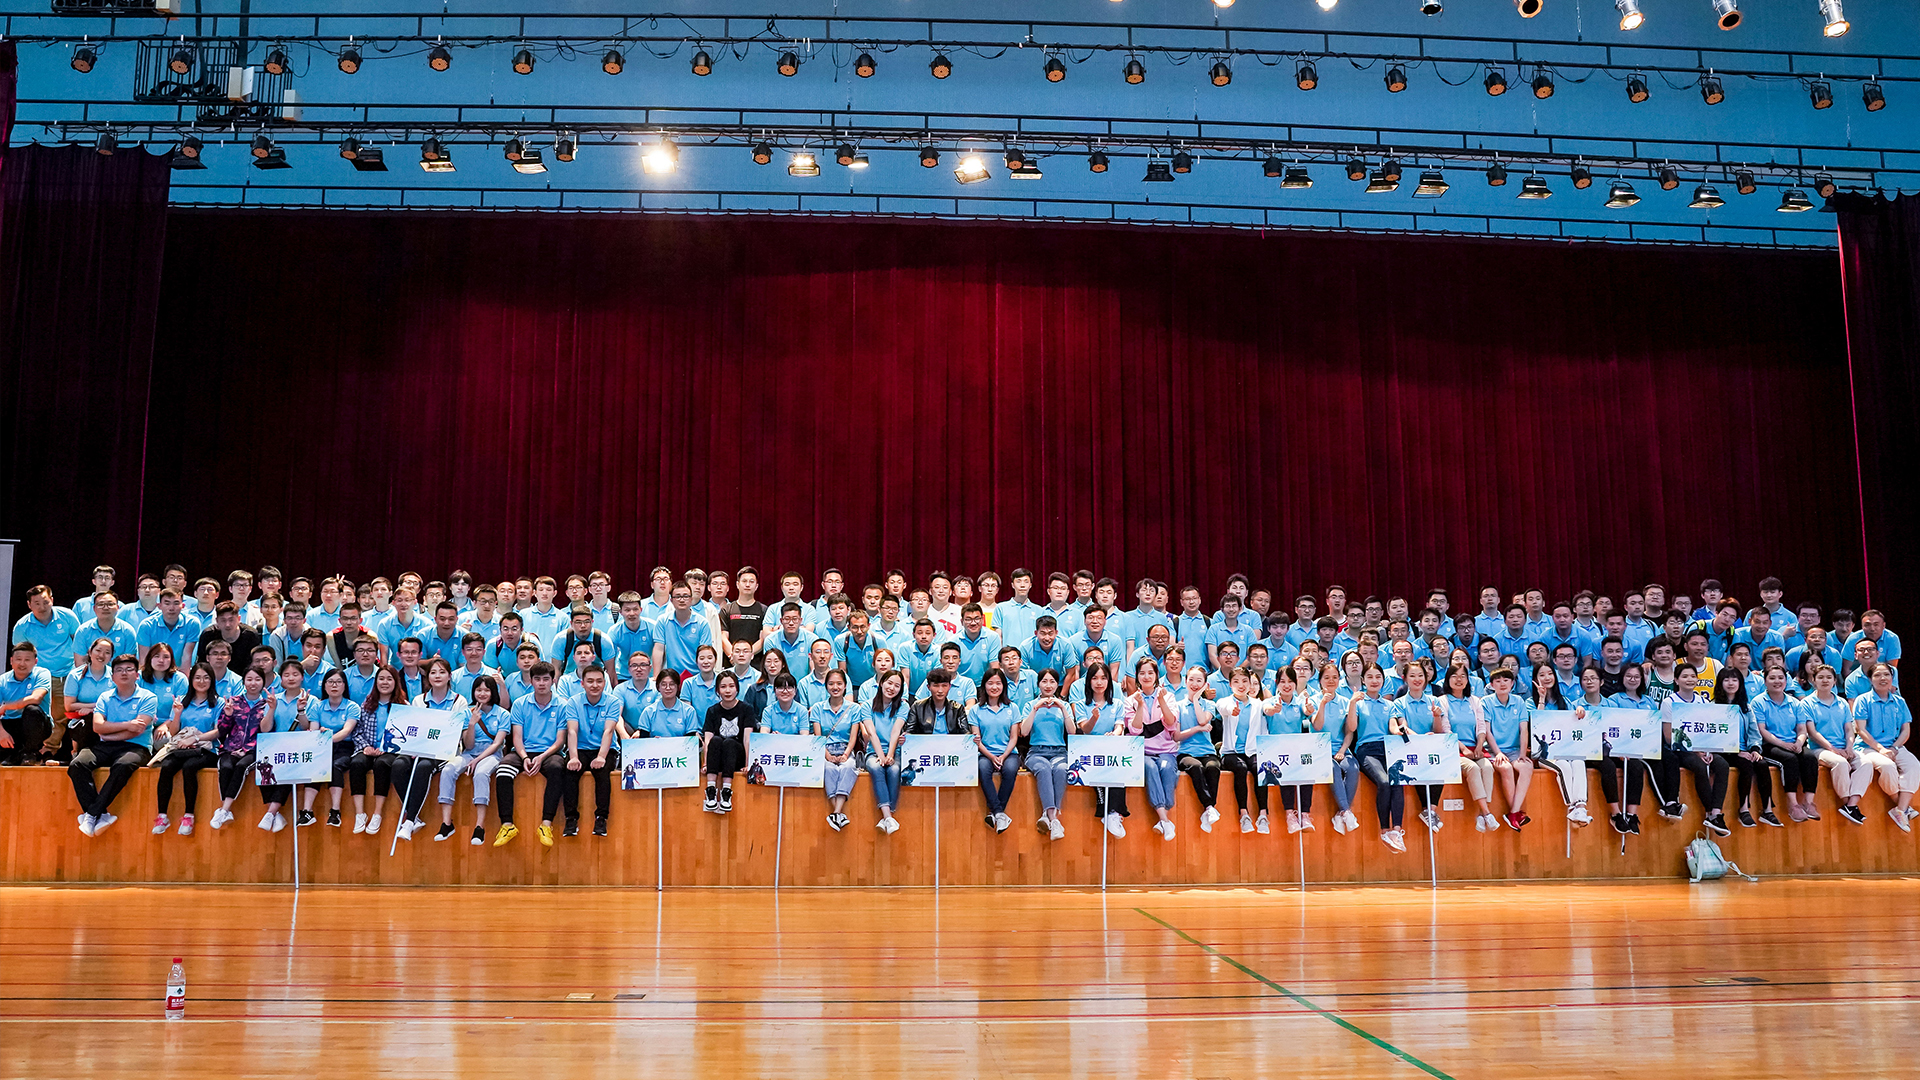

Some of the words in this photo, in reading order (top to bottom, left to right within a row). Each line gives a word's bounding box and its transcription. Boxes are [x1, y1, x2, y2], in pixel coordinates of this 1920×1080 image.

[406, 726, 441, 740] 鹰眼
[1608, 727, 1642, 739] 雷神
[1681, 721, 1729, 734] 无敌浩克
[1550, 729, 1583, 741] 幻视
[274, 752, 313, 764] 钢铁侠
[634, 756, 687, 769] 惊奇队长
[760, 754, 813, 767] 奇异博士
[919, 755, 959, 767] 金刚狼
[1080, 755, 1133, 767] 美国队长
[1278, 753, 1313, 766] 灭霸
[1406, 754, 1441, 766] 黑豹
